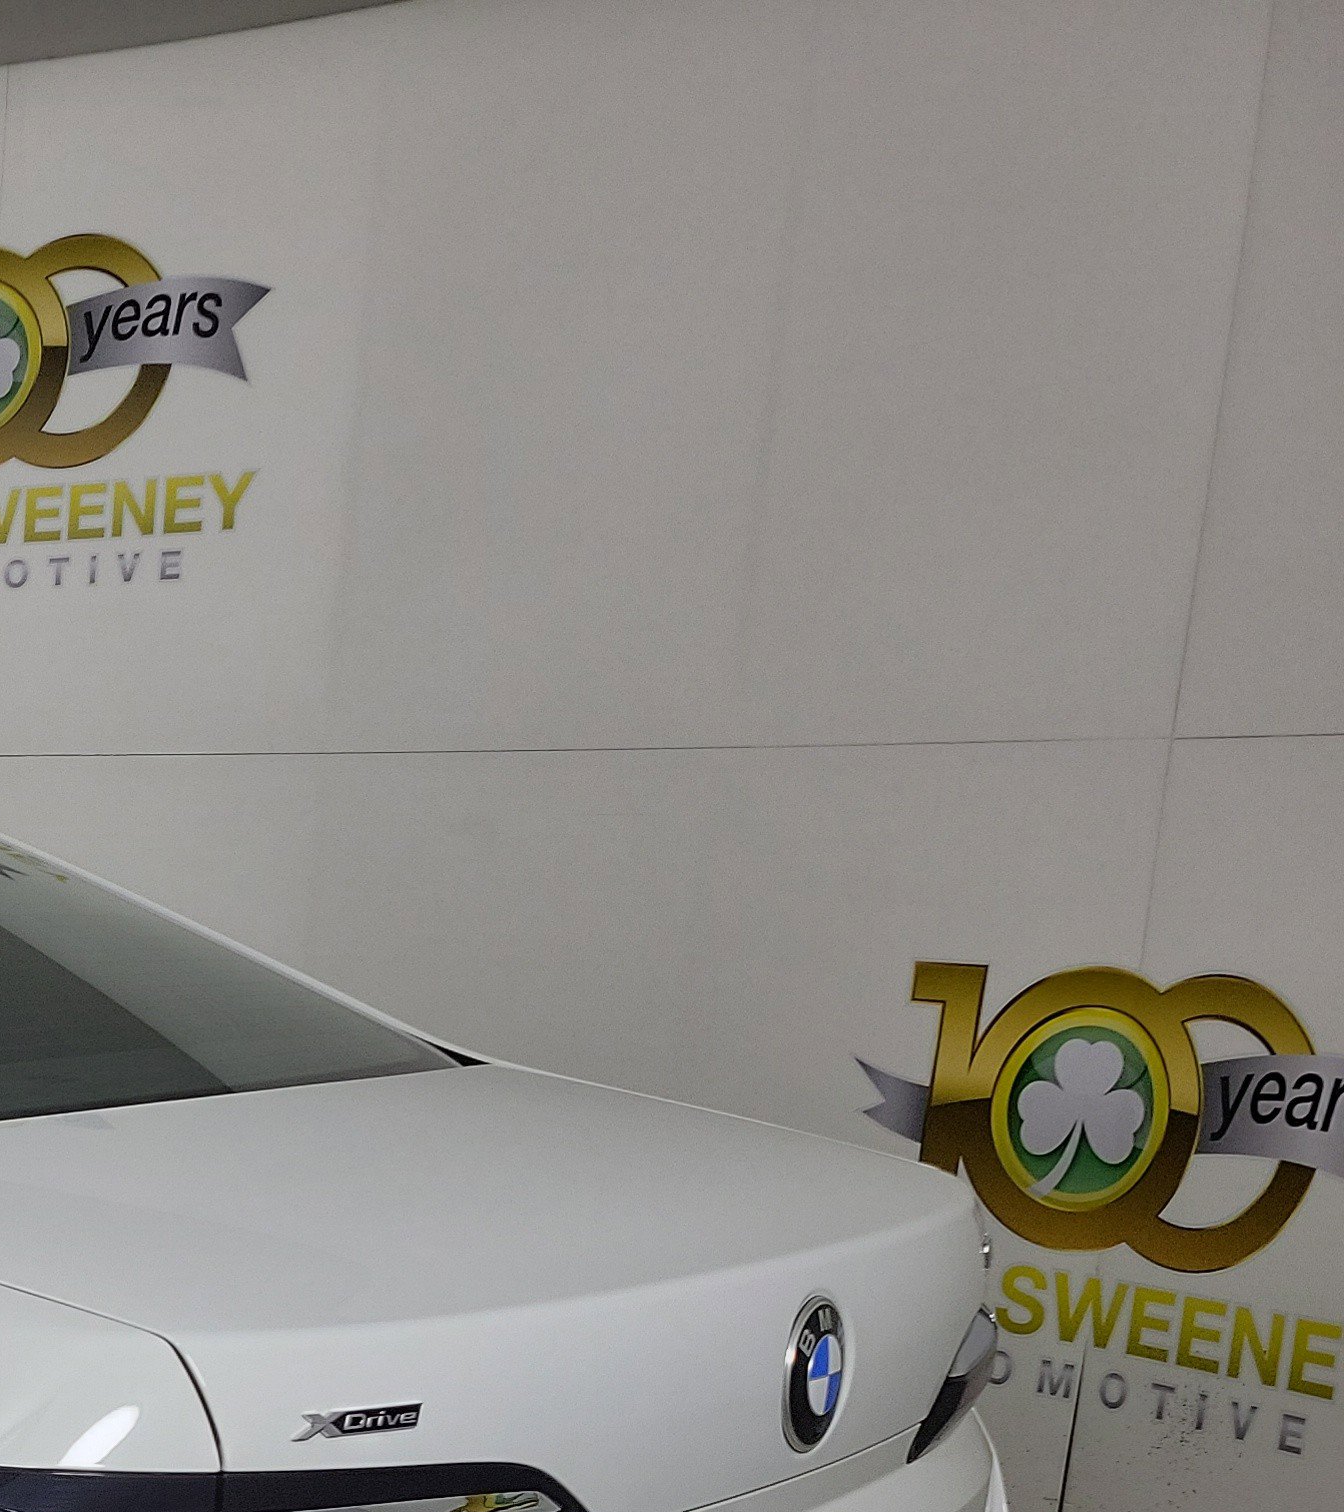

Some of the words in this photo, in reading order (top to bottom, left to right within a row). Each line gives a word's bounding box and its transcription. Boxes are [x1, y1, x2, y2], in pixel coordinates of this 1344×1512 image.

[80, 290, 223, 363] years
[1210, 1070, 1344, 1142] year
[995, 1264, 1344, 1400] SWEENE
[992, 1350, 1307, 1456] OMOTIVE
